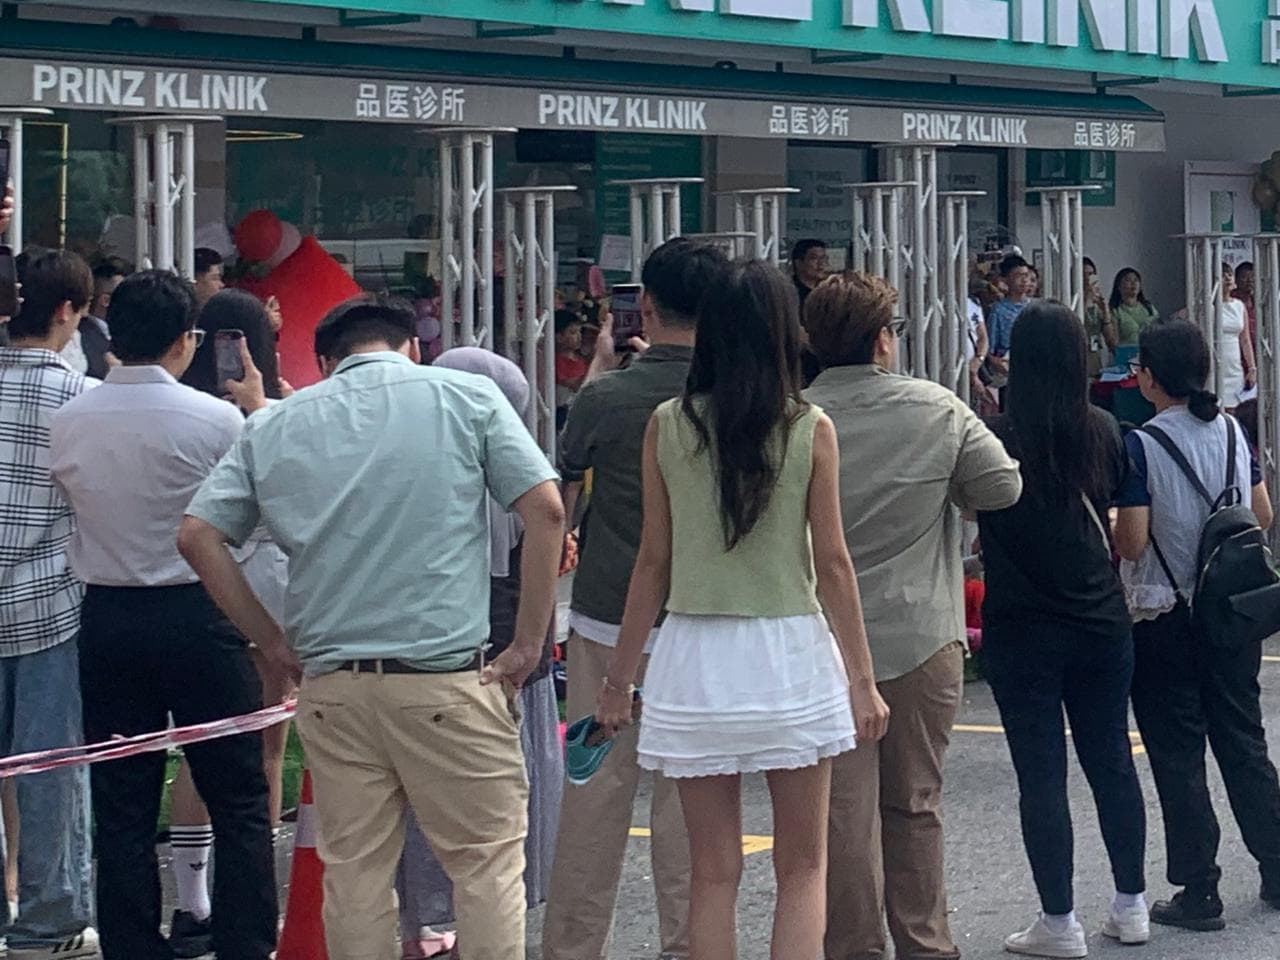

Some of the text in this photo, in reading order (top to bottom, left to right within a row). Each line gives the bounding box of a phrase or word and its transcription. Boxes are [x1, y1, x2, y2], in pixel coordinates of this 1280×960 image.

[33, 64, 268, 112] PRINZ KLINIK
[355, 83, 466, 122] 品医诊所
[539, 94, 706, 130] PRINZ KLINIK
[769, 105, 849, 136] 品医诊所
[903, 112, 1027, 145] PRINZ KLINIK
[1073, 121, 1135, 149] 品医诊所
